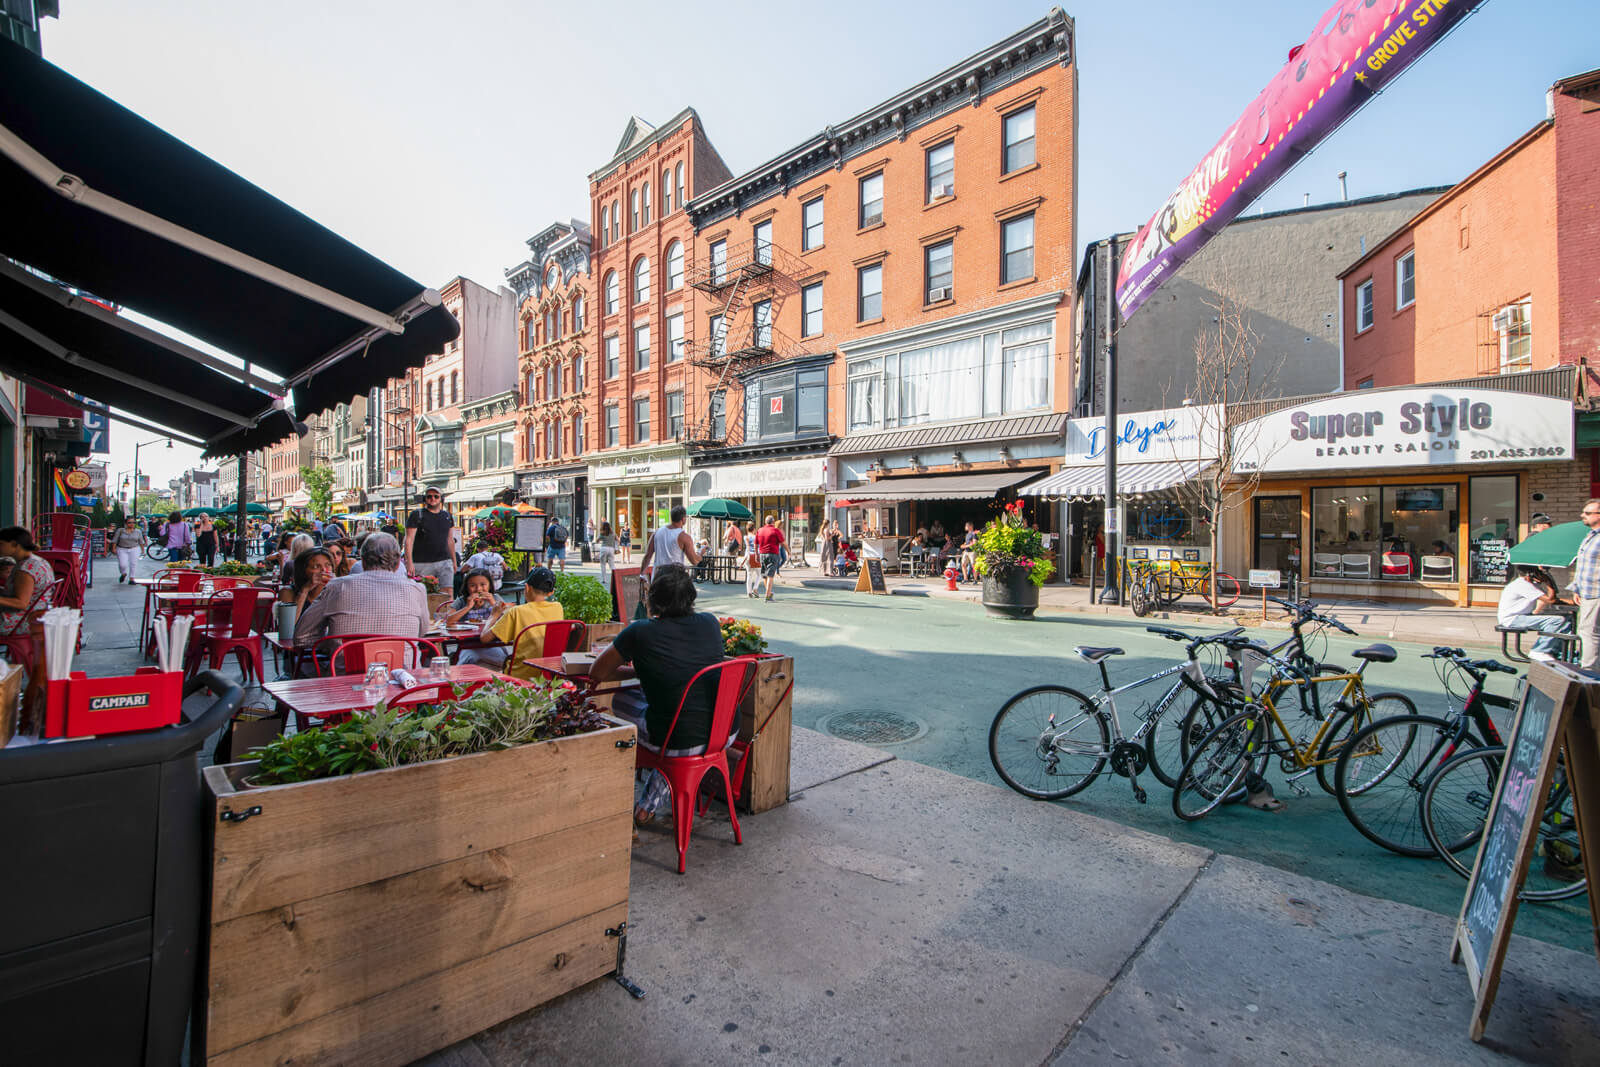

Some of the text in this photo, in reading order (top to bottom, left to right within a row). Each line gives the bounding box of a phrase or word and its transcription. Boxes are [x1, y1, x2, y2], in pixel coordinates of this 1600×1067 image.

[1366, 20, 1417, 71] GROVE
[1290, 398, 1493, 444] Super Style
[1315, 439, 1460, 457] BEAUTY SALON
[1239, 461, 1257, 470] 126
[92, 695, 147, 709] CAMPARI
